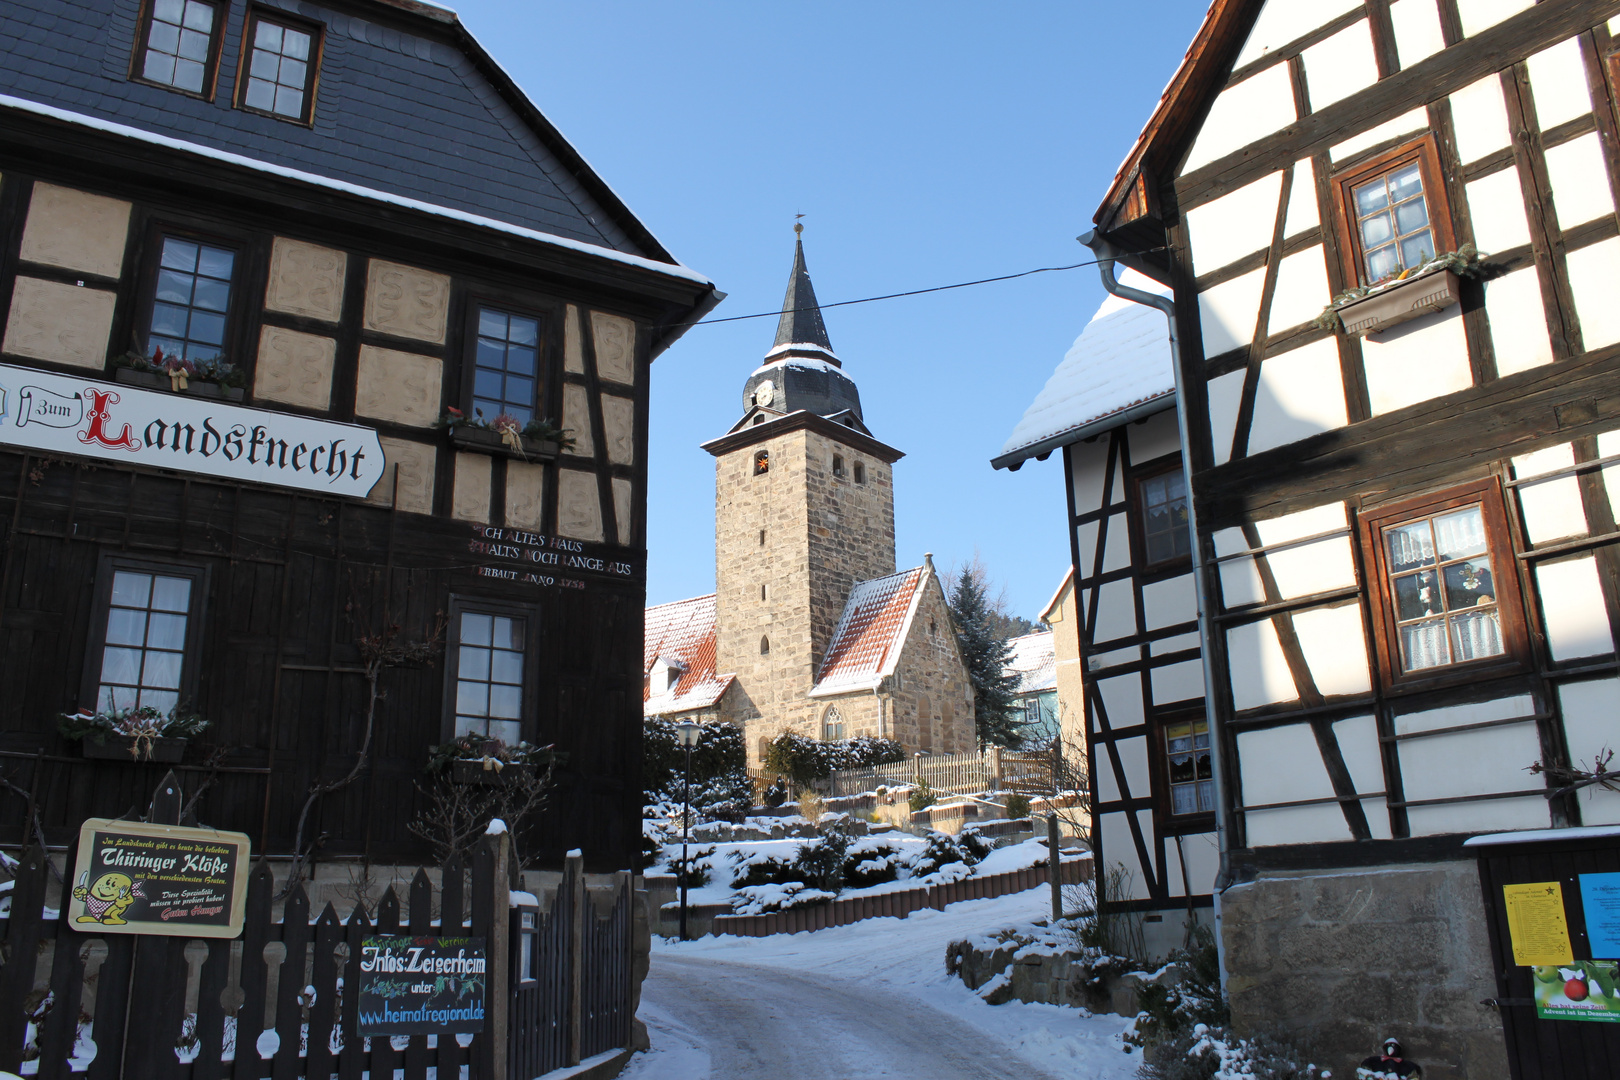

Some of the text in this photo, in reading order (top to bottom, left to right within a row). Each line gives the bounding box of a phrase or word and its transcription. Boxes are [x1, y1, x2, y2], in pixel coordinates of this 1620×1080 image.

[36, 387, 366, 484] Zum Landsknecht
[480, 526, 583, 552] ICH ALTES HAUS
[524, 549, 559, 565] NOCH
[562, 555, 604, 571] LANGE
[606, 561, 632, 576] AUS
[477, 567, 518, 580] ERBAUT
[521, 573, 554, 587] ANNO
[102, 837, 114, 845] Im
[115, 838, 154, 849] Landsknecht
[155, 841, 169, 850] gibt
[177, 843, 193, 851] heute
[194, 844, 204, 852] die
[204, 846, 230, 854] beliebten
[100, 847, 229, 876] Thüringer Klöße
[146, 872, 158, 880] den
[159, 873, 203, 883] verschiedensten
[150, 894, 225, 907] müssen sie probiert haben!
[161, 889, 214, 899] Diese Spezialität
[160, 905, 223, 921] Guten Hunger
[362, 936, 413, 955] Thüringer
[405, 947, 486, 974] Zeigerheim
[411, 980, 436, 994] unter:
[360, 999, 485, 1026] www.heimatregional.de
[1587, 1010, 1620, 1018] Dezember.
